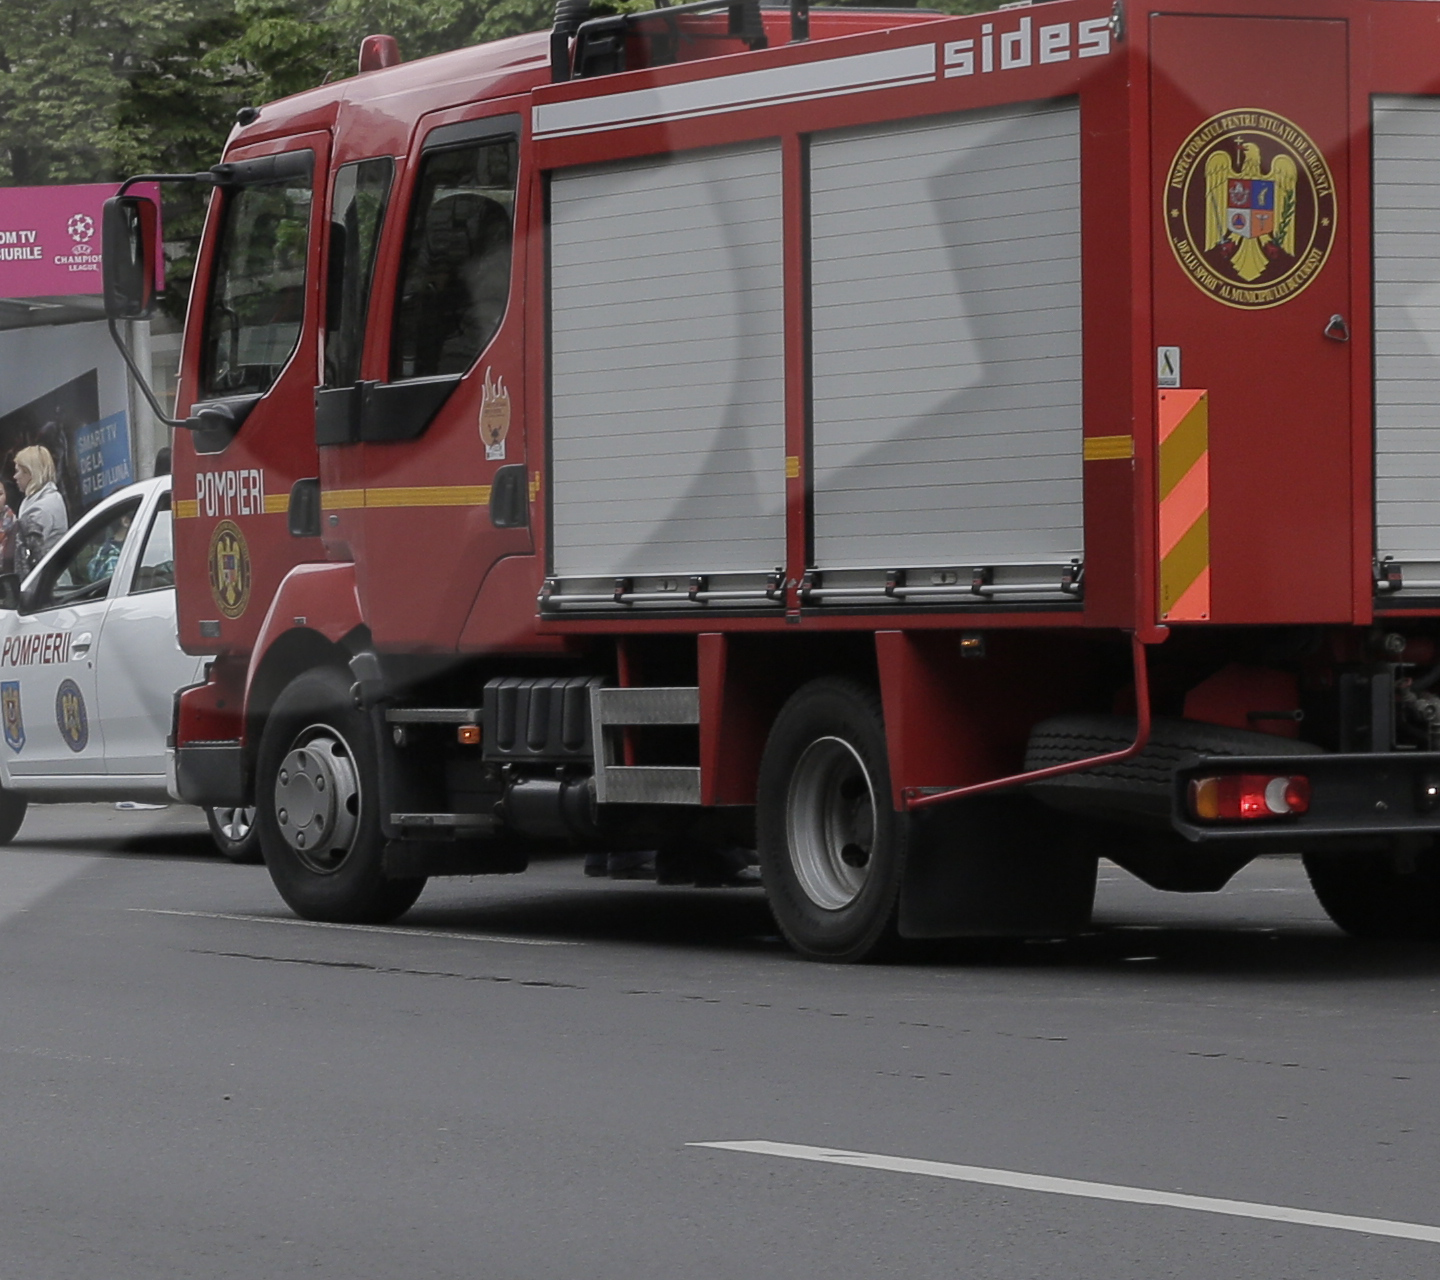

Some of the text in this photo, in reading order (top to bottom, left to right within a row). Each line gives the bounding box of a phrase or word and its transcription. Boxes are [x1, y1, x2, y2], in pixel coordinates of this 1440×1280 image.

[943, 17, 1111, 80] sides
[1223, 114, 1259, 131] PENTRU
[1294, 137, 1307, 153] DE
[19, 230, 37, 244] TV
[54, 254, 102, 264] CHAMPIO
[1220, 286, 1233, 298] AL
[106, 422, 118, 440] TV
[196, 469, 265, 518] POMPIERI
[0, 632, 72, 667] POMPIERII
